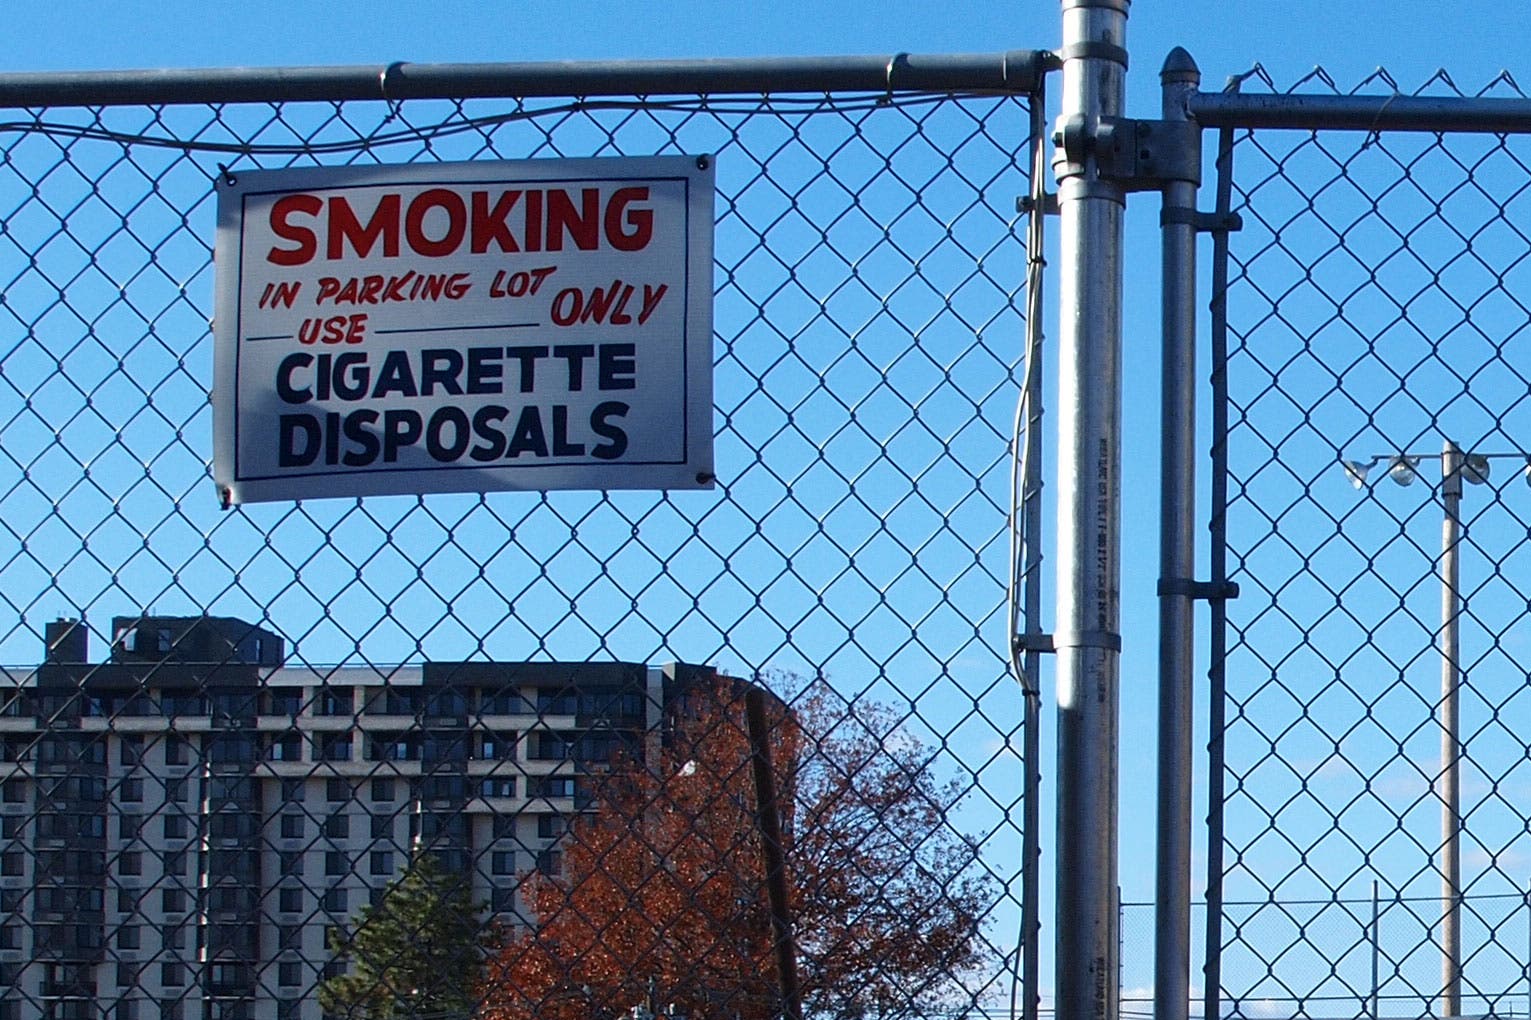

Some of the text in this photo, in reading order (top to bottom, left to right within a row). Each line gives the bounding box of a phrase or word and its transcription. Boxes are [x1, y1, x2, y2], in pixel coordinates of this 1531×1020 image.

[266, 186, 655, 266] SMOKING
[259, 266, 668, 326] IN PARKING LOT ONLY
[299, 314, 368, 344] USE
[276, 343, 636, 404] CIGARETTE
[279, 401, 630, 467] DISPOSALS
